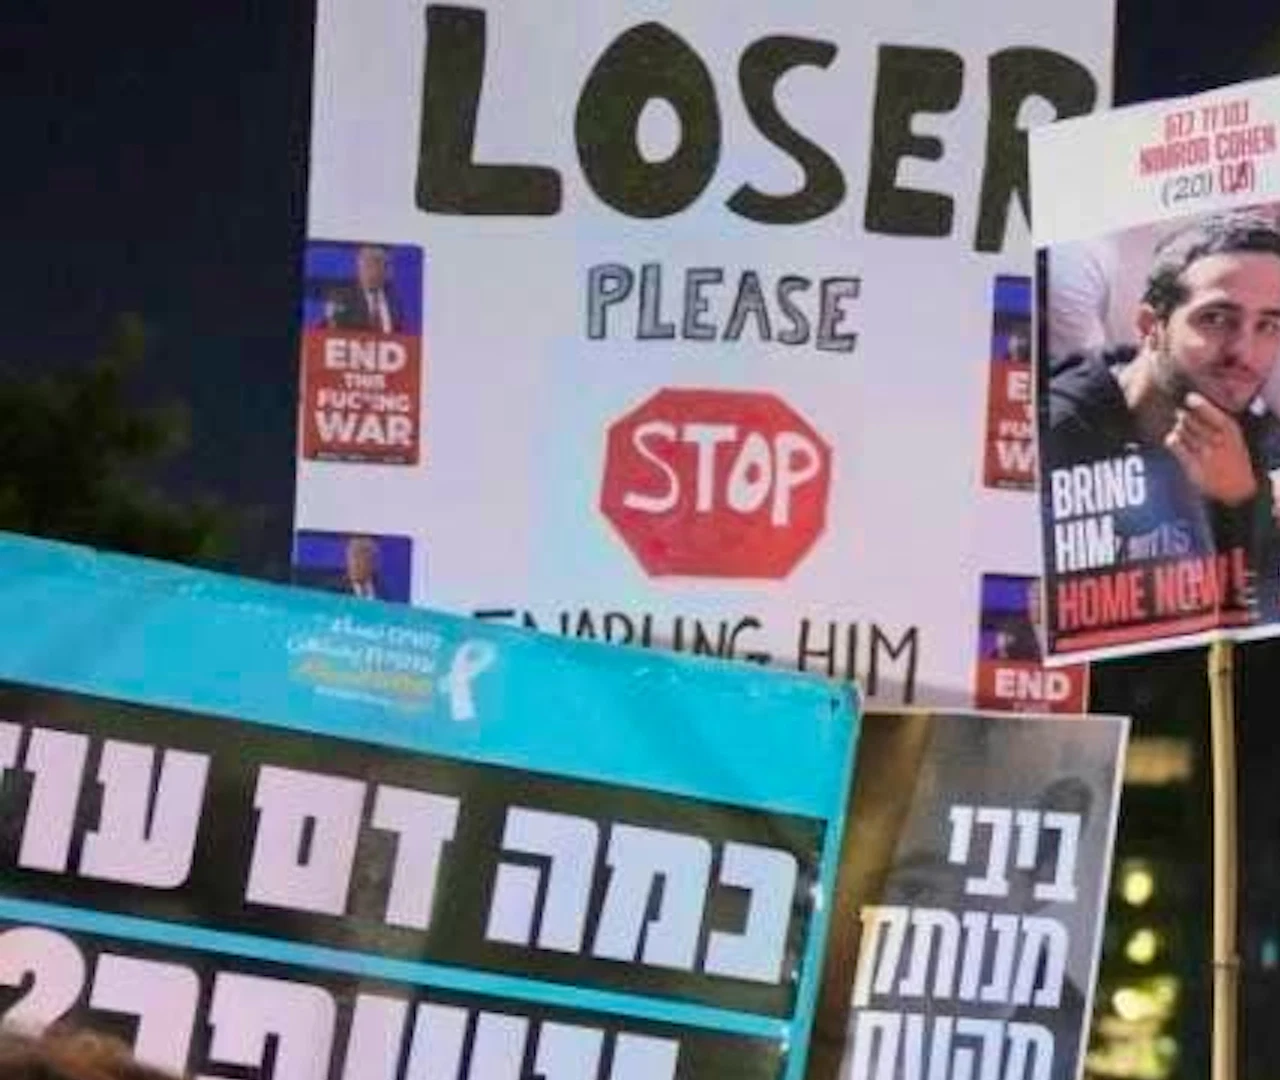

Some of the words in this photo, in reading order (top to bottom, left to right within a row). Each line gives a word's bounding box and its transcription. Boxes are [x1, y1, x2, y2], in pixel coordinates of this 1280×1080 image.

[414, 3, 1098, 254] LOSER
[1214, 123, 1276, 161] COHEN
[587, 261, 863, 353] PLEASE
[324, 337, 408, 373] END
[314, 409, 413, 447] WAR
[623, 421, 820, 527] STOP
[1050, 454, 1146, 519] BRING
[1054, 513, 1116, 574] HIM
[1057, 567, 1145, 632] HOME
[1153, 547, 1249, 618] NOW!
[798, 617, 919, 705] HIM
[994, 667, 1072, 701] END
[245, 763, 460, 931] דם
[947, 804, 1081, 902] ביבי
[486, 806, 798, 984] כמה
[852, 905, 1070, 1009] מנותק
